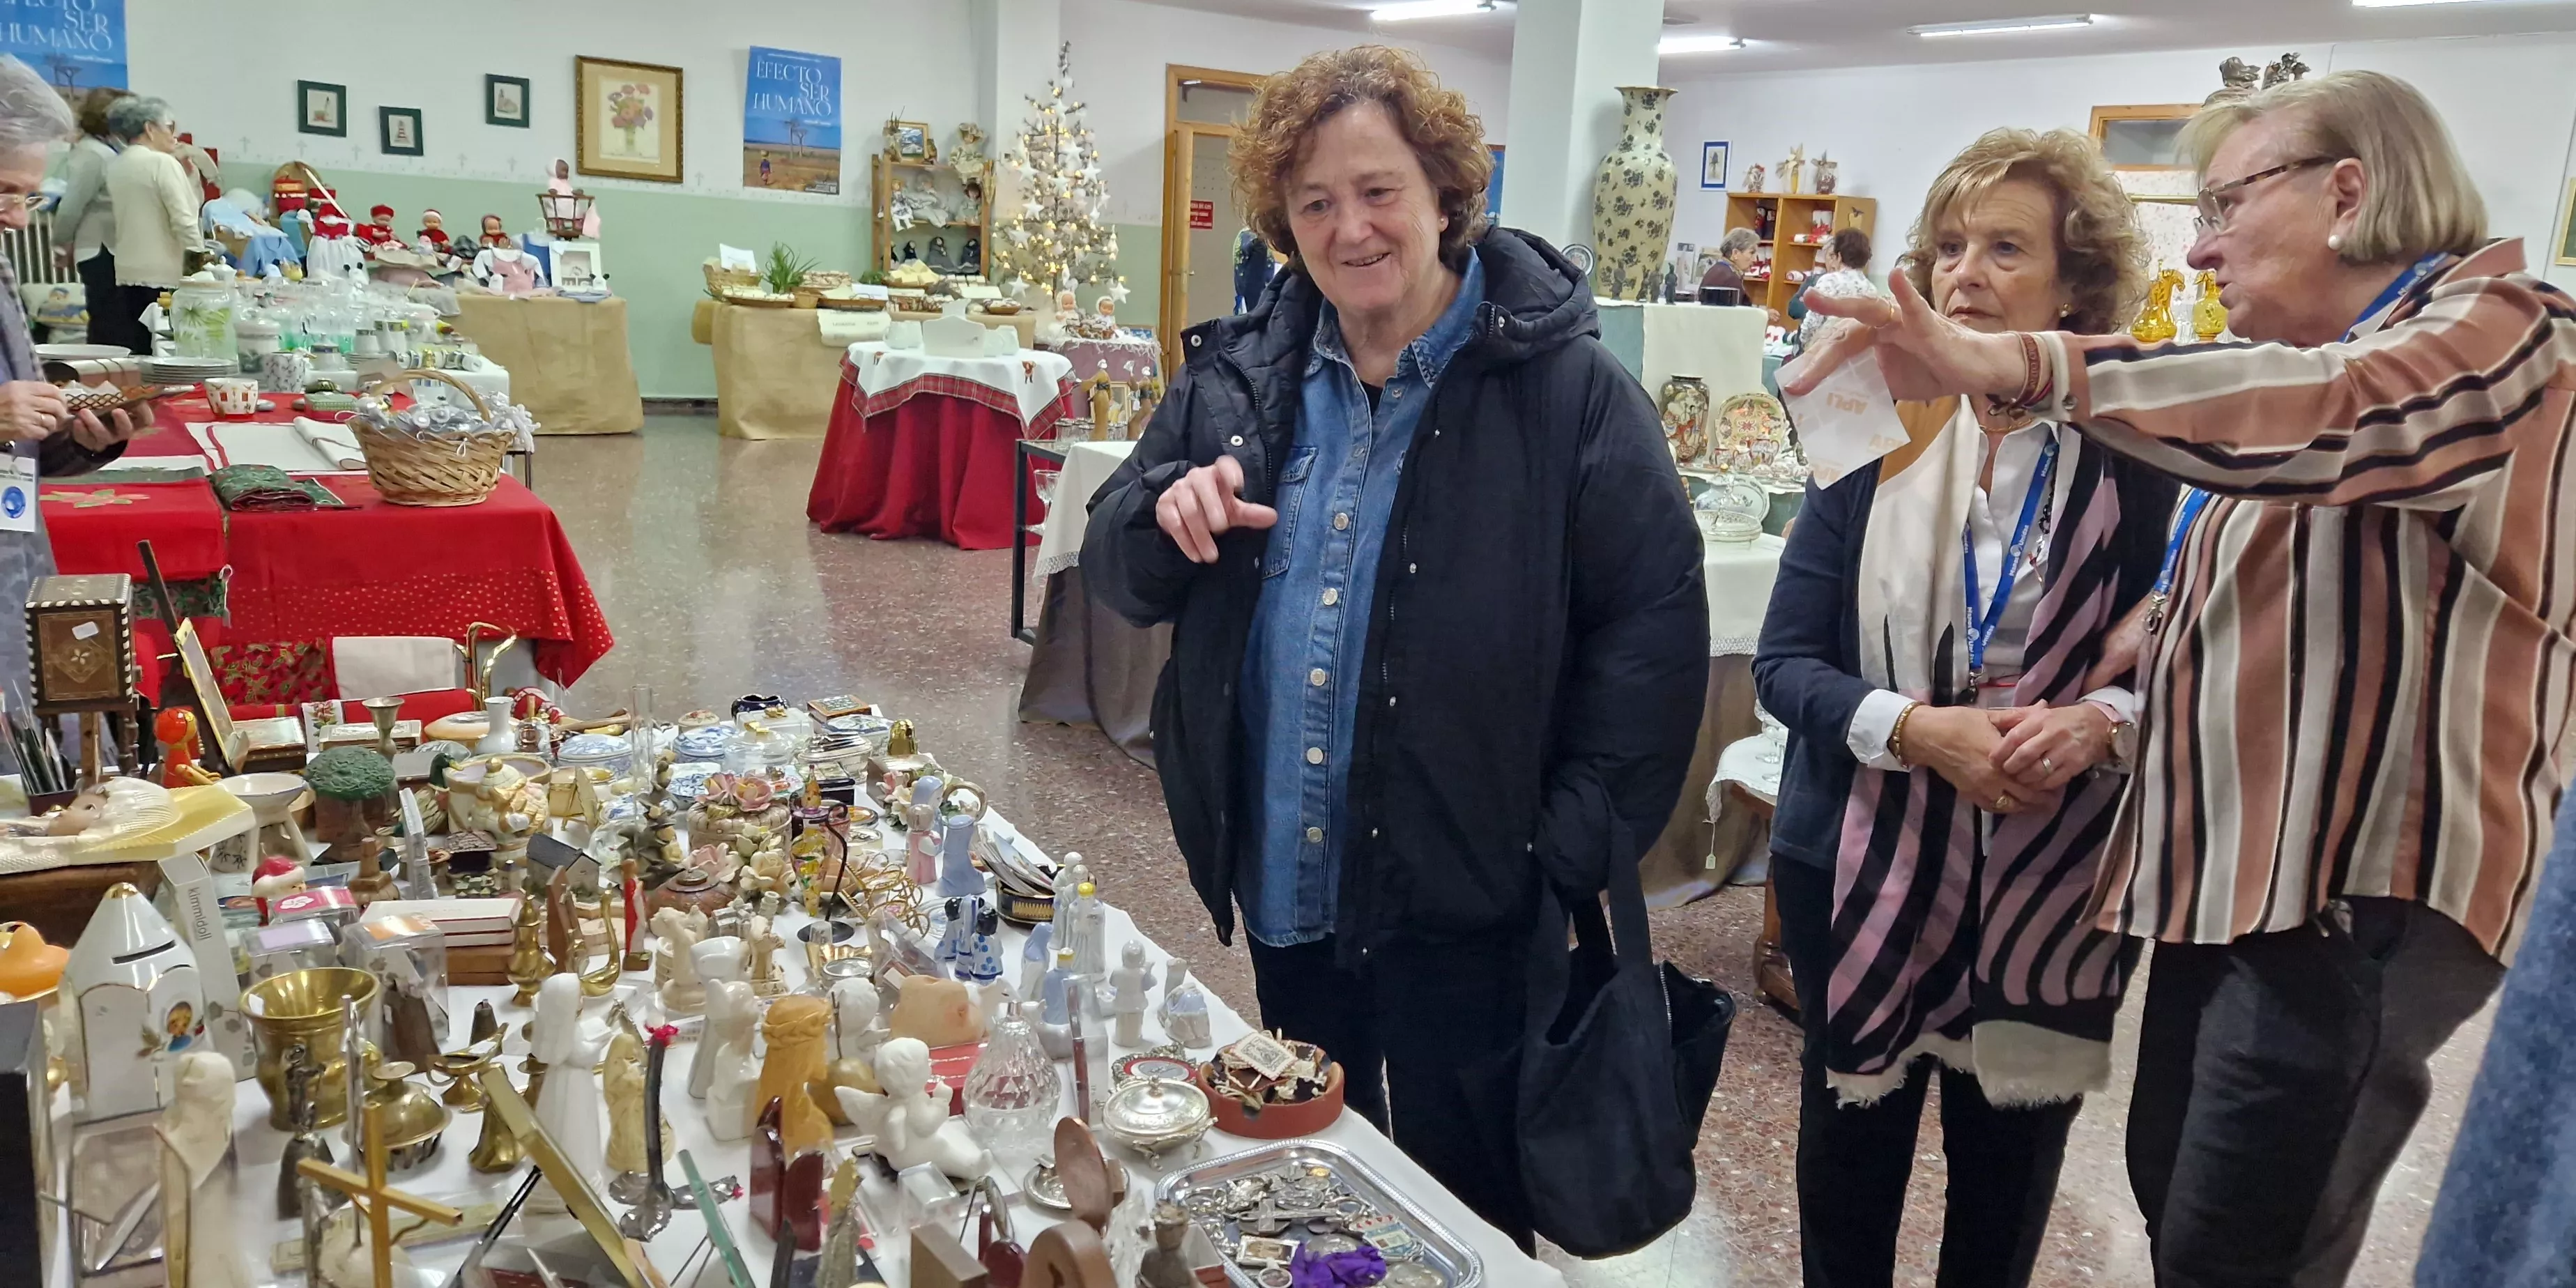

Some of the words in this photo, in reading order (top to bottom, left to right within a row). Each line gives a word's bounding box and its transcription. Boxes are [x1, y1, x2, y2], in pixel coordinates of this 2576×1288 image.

[64, 10, 108, 34] SER
[756, 61, 822, 84] EFECTO
[799, 83, 829, 102] SER
[753, 93, 831, 117] HUMANO
[1826, 392, 1868, 415] APLI
[2009, 556, 2019, 577] Manos
[2019, 524, 2030, 546] Unidas
